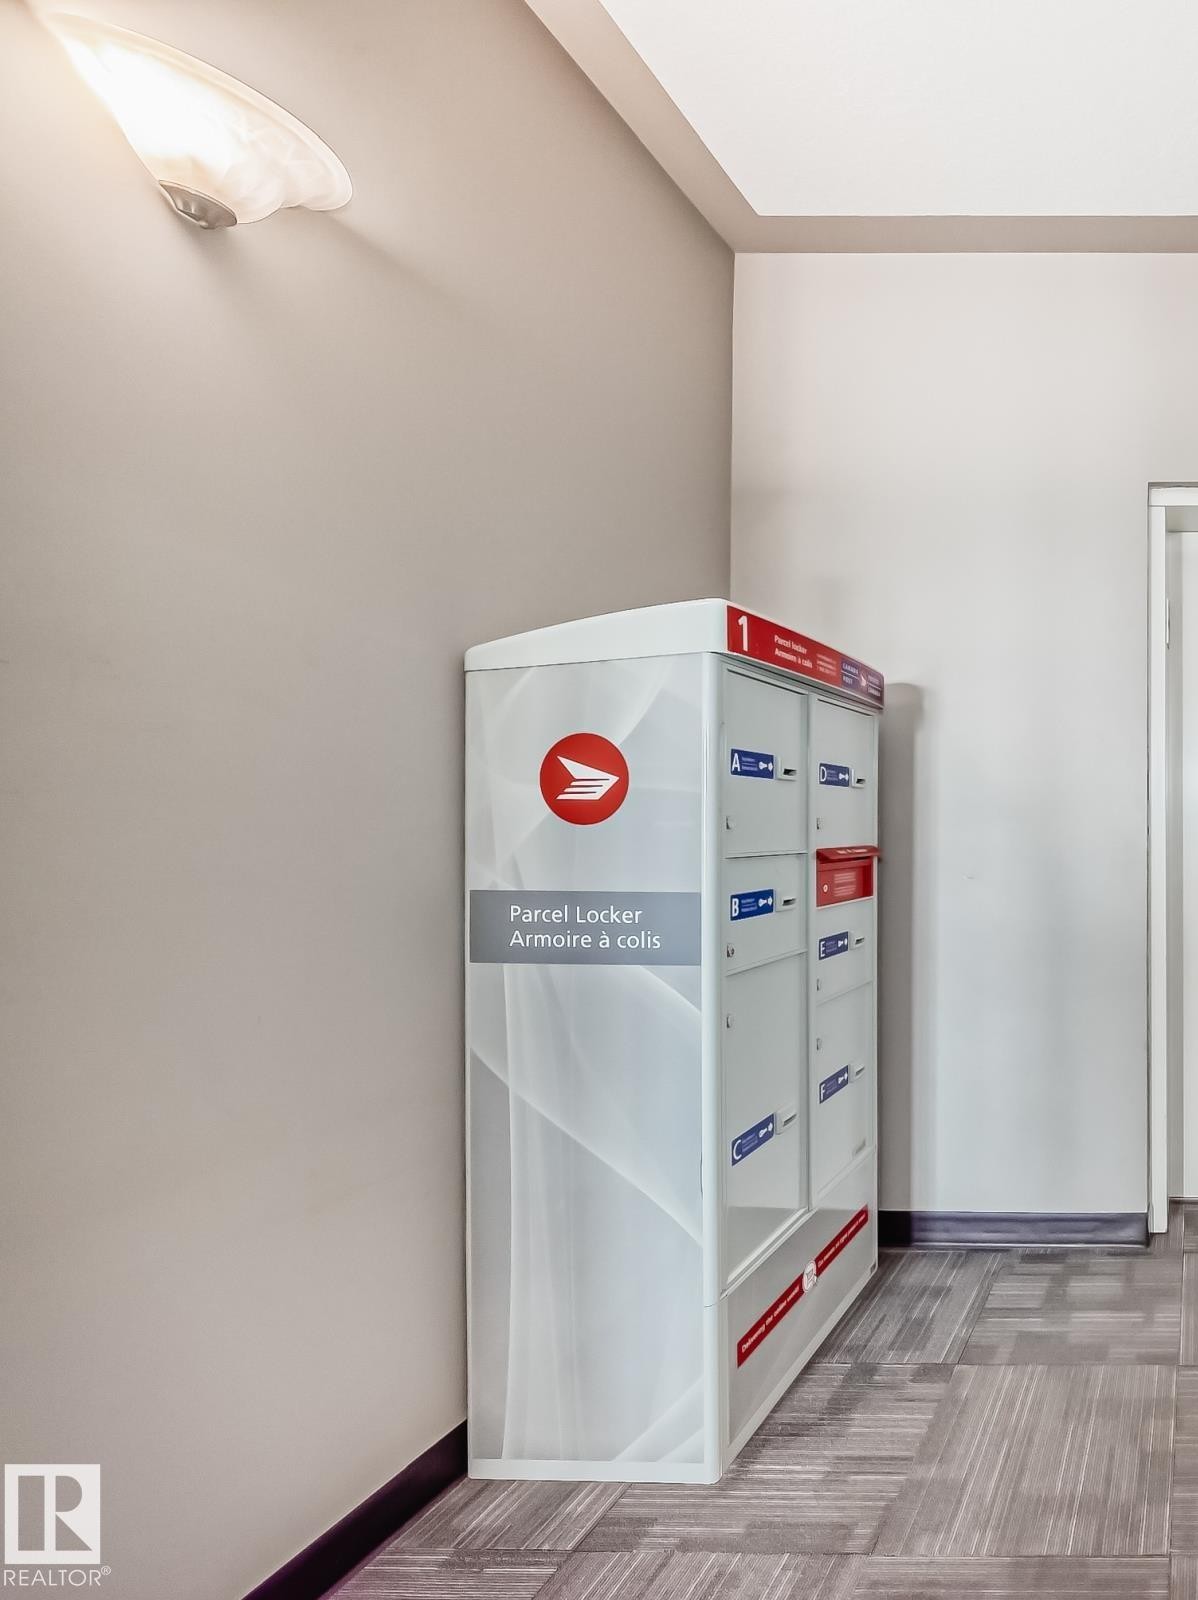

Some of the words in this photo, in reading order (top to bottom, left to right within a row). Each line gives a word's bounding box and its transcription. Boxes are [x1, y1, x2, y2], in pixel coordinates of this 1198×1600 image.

[738, 615, 748, 652] 1
[731, 753, 741, 772] A
[820, 766, 827, 782] D
[509, 904, 569, 923] Parcel
[576, 905, 643, 924] Locker
[731, 898, 740, 917] B
[508, 930, 592, 948] Armoire
[598, 931, 610, 949] à
[616, 930, 662, 949] colis
[820, 941, 826, 957] E
[820, 1083, 826, 1100] F
[733, 1139, 742, 1160] C
